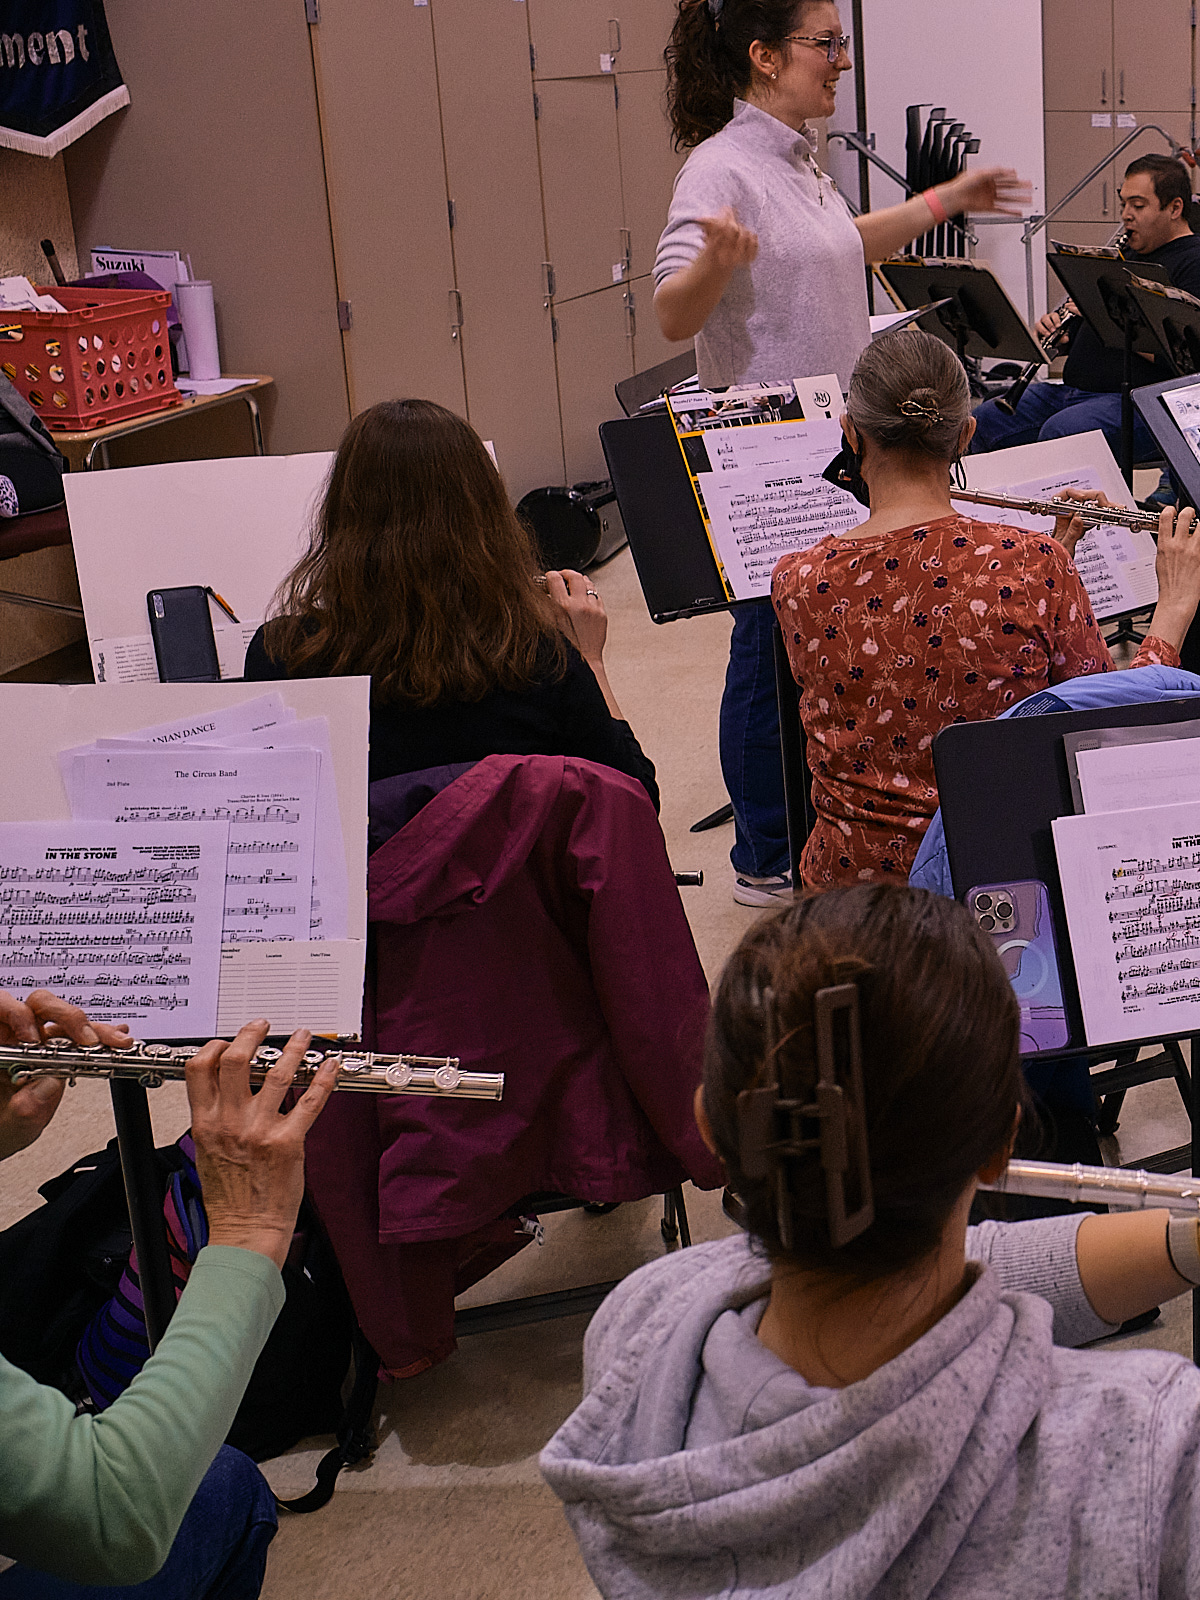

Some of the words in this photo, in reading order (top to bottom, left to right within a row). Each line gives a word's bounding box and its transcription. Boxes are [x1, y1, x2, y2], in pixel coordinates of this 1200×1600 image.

[96, 256, 145, 271] Suzuki
[182, 722, 217, 739] DANCE
[174, 770, 189, 778] The
[192, 770, 217, 778] Circus
[219, 769, 238, 777] Band
[45, 852, 57, 860] IN
[60, 852, 81, 860] THE
[83, 852, 118, 860] STONE
